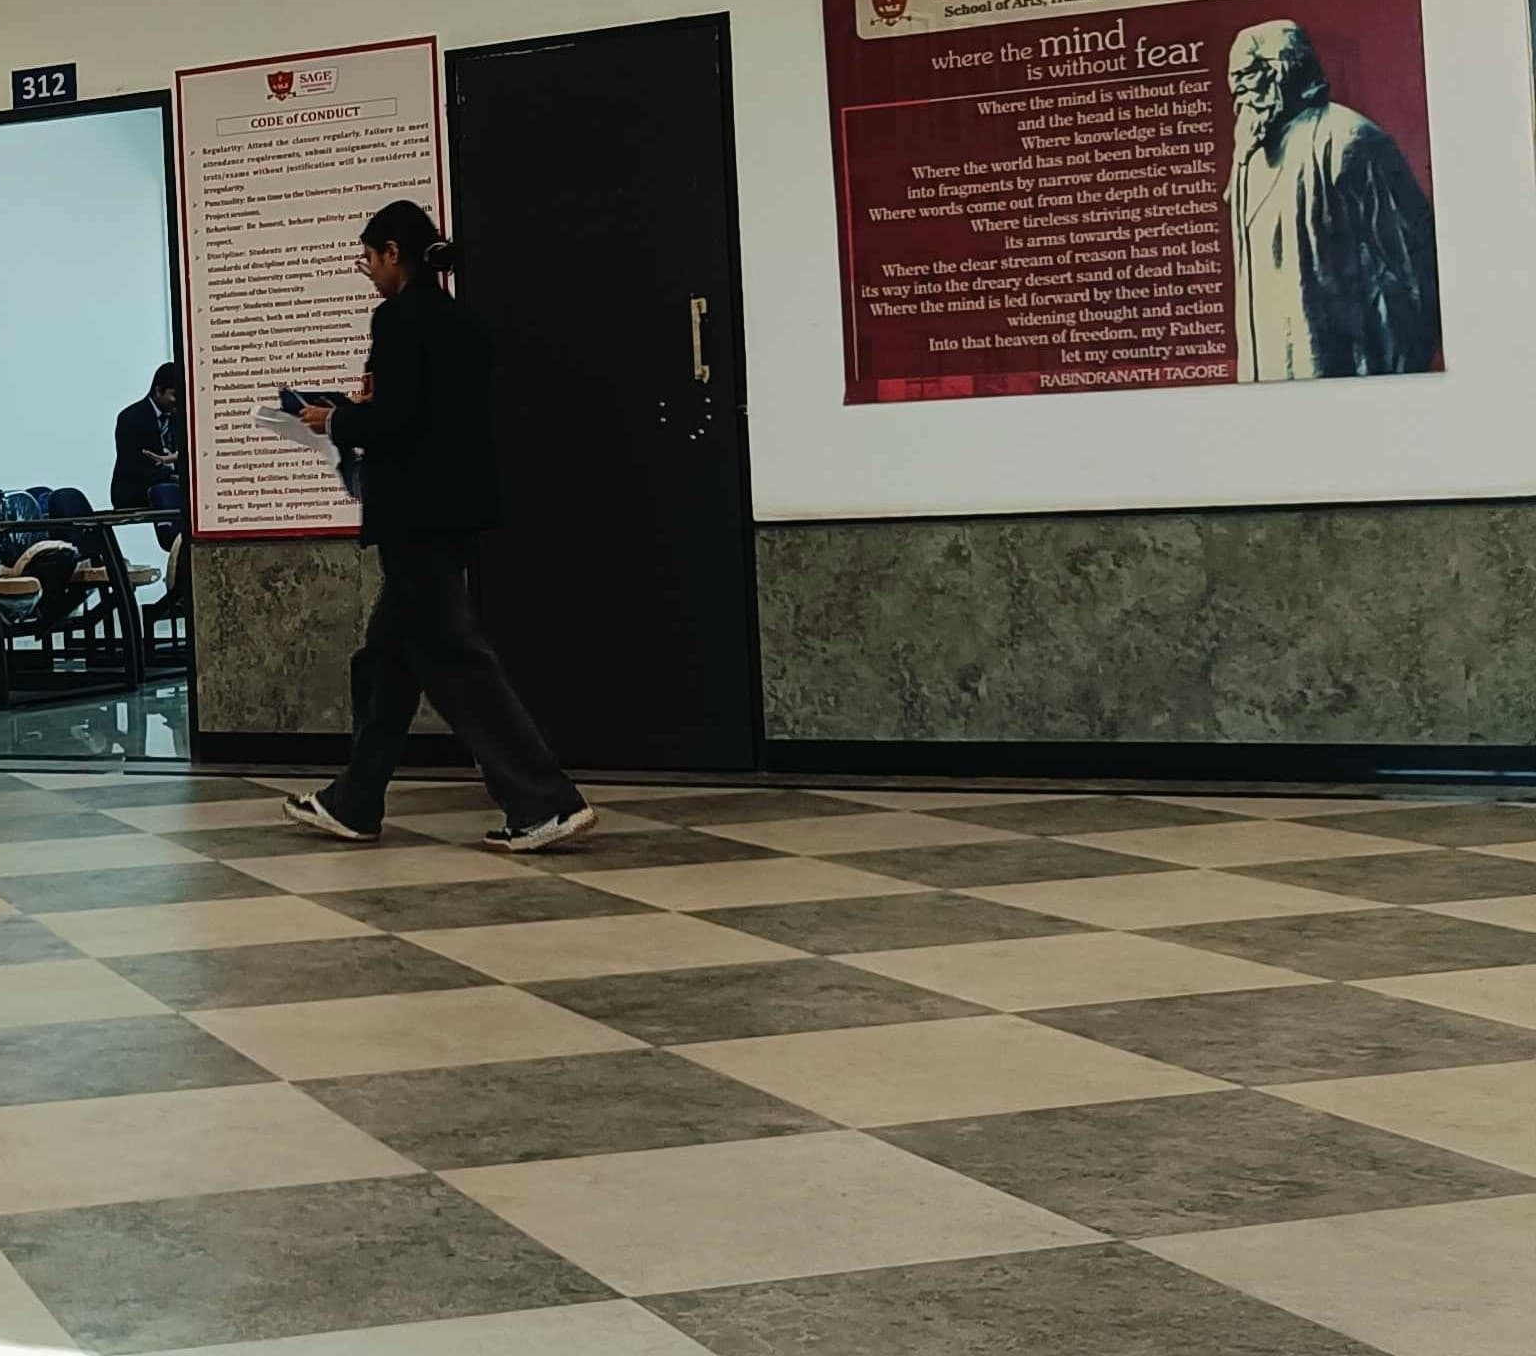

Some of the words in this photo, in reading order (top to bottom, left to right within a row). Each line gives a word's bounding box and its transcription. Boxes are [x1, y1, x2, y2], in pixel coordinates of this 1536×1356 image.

[944, 0, 992, 18] School
[932, 49, 993, 69] where
[1000, 42, 1032, 62] the
[1040, 17, 1126, 57] mind
[1027, 66, 1042, 80] is
[1048, 54, 1126, 77] without
[1135, 38, 1203, 68] fear
[21, 72, 66, 100] 312
[299, 71, 332, 84] SAGE
[977, 100, 1026, 114] Where
[1030, 96, 1054, 110] the
[1058, 89, 1096, 107] mind
[1100, 91, 1112, 102] is
[1116, 83, 1175, 100] without
[1179, 80, 1211, 94] fear
[250, 115, 283, 129] CODE
[286, 113, 299, 125] of
[300, 106, 361, 123] CONDUCT
[1017, 115, 1045, 131] and
[1049, 113, 1073, 127] the
[1077, 107, 1114, 124] head
[1118, 109, 1131, 120] is
[1135, 102, 1168, 118] held
[1021, 135, 1070, 149] Where
[1074, 125, 1155, 144] knowledge
[1160, 125, 1173, 136] is
[912, 165, 960, 178] Where
[964, 161, 987, 175] the
[990, 155, 1033, 172] world
[1036, 154, 1063, 168] has
[1066, 151, 1091, 165] not
[1094, 149, 1132, 162] been
[1135, 142, 1190, 158] broken
[1194, 141, 1214, 156] up
[908, 186, 935, 199] into
[938, 179, 1014, 198] fragments
[1016, 176, 1035, 192] by
[1038, 173, 1093, 187] narrow
[1096, 163, 1166, 182] domestic
[868, 207, 916, 220] Where
[919, 201, 963, 216] words
[966, 200, 1006, 213] come
[1010, 196, 1034, 209] out
[1038, 193, 1073, 207] from
[1077, 189, 1101, 204] the
[1105, 184, 1149, 203] depth
[1152, 182, 1168, 197] of
[971, 218, 1019, 232] Where
[1023, 212, 1078, 228] tireless
[1082, 206, 1141, 223] striving
[1144, 200, 1218, 217] stretches
[1005, 235, 1023, 249] its
[1027, 234, 1066, 247] arms
[1070, 225, 1130, 244] towards
[882, 263, 929, 276] Where
[933, 260, 956, 274] the
[960, 258, 997, 272] clear
[1001, 255, 1053, 269] stream
[1056, 250, 1072, 264] of
[1075, 249, 1126, 263] reason
[1130, 245, 1158, 259] has
[1162, 242, 1187, 256] not
[1191, 239, 1220, 254] lost
[862, 285, 879, 297] its
[882, 285, 910, 295] way
[914, 281, 942, 294] into
[945, 278, 969, 292] the
[972, 276, 1022, 291] dreary
[1025, 271, 1073, 286] desert
[1076, 266, 1113, 282] sand
[1116, 264, 1132, 280] of
[1134, 261, 1172, 278] dead
[870, 302, 917, 316] Where
[920, 299, 944, 313] the
[948, 295, 984, 311] mind
[988, 298, 1001, 309] is
[1004, 292, 1027, 308] led
[1031, 288, 1090, 306] forward
[1093, 287, 1112, 304] by
[1116, 285, 1149, 300] thee
[1153, 283, 1183, 297] into
[1187, 281, 1223, 294] ever
[1007, 310, 1076, 326] widening
[1079, 305, 1138, 323] thought
[1142, 302, 1172, 317] and
[1175, 299, 1224, 315] action
[929, 338, 958, 351] Into
[962, 335, 991, 349] that
[995, 334, 1048, 347] heaven
[1052, 329, 1066, 343] of
[1070, 326, 1137, 342] freedom,
[1141, 325, 1166, 340] my
[1170, 321, 1225, 336] Father,
[1061, 349, 1081, 363] let
[1084, 350, 1108, 364] my
[1112, 345, 1172, 360] country
[1175, 339, 1226, 356] awake
[1040, 367, 1160, 387] RABINDRANATH
[1163, 363, 1228, 380] TAGORE
